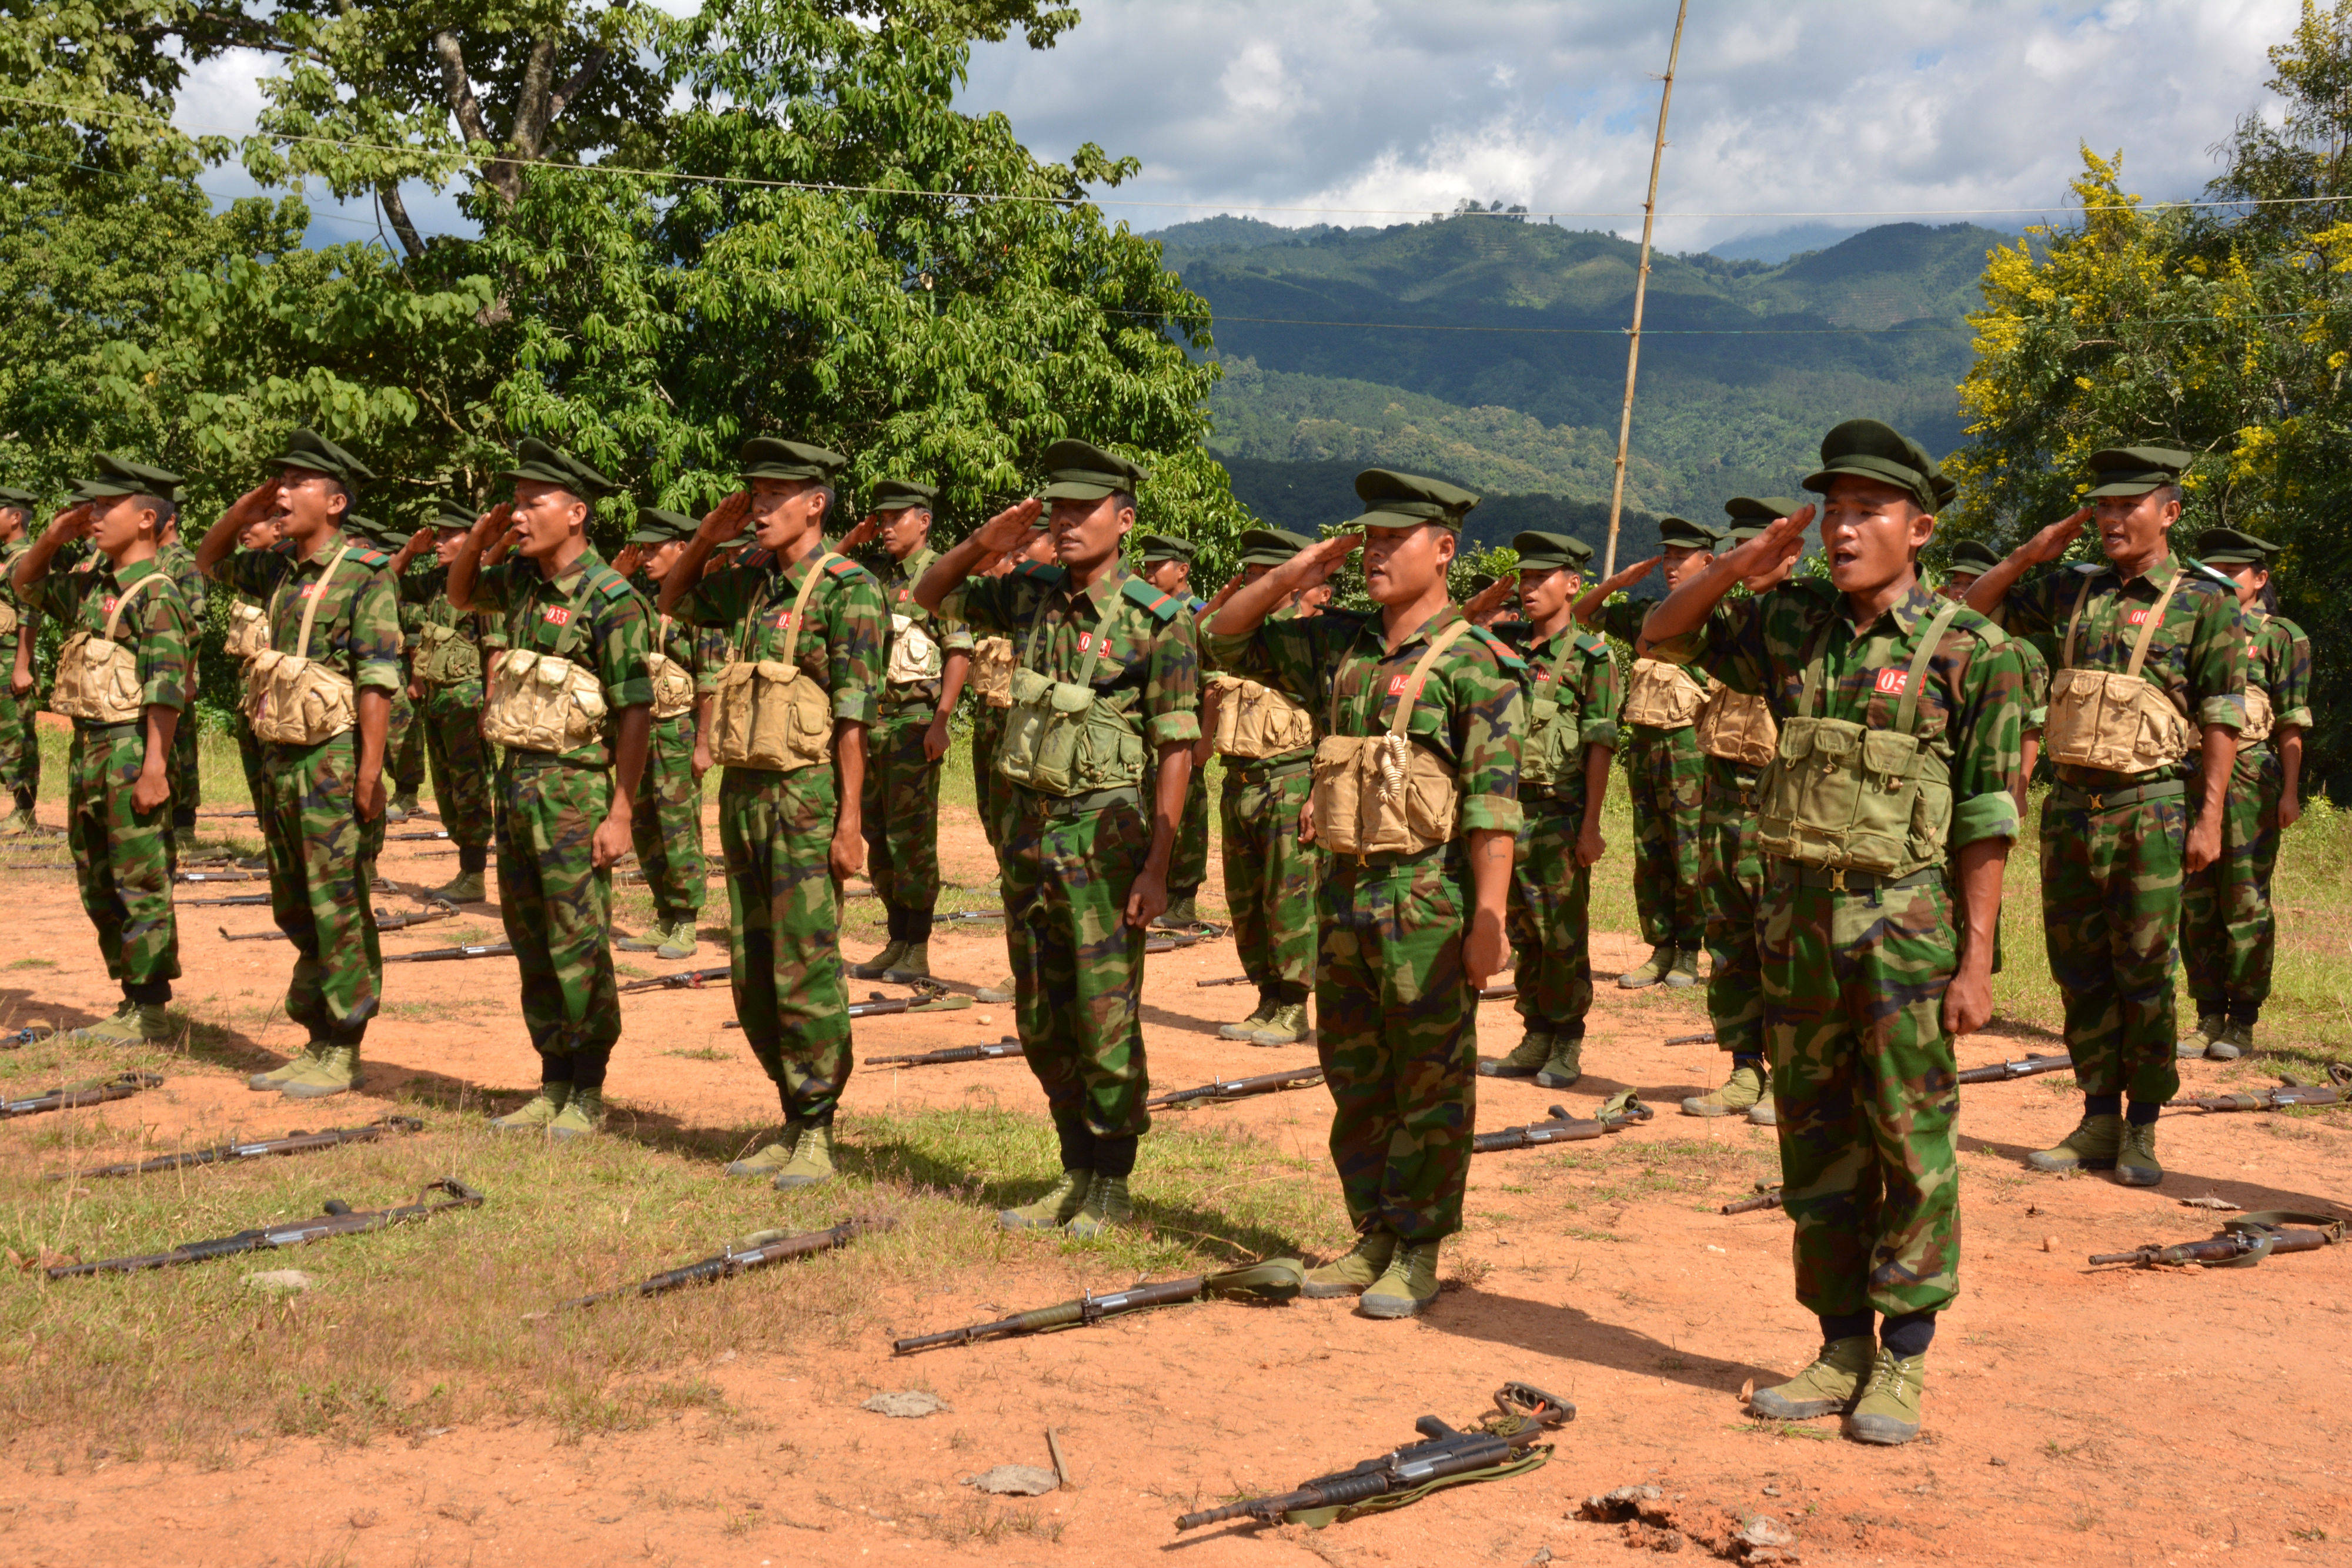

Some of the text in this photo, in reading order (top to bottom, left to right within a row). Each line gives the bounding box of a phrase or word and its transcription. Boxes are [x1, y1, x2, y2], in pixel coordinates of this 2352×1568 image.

[547, 607, 567, 624] 033
[1391, 676, 1419, 691] 04
[1881, 672, 1907, 691] 05
